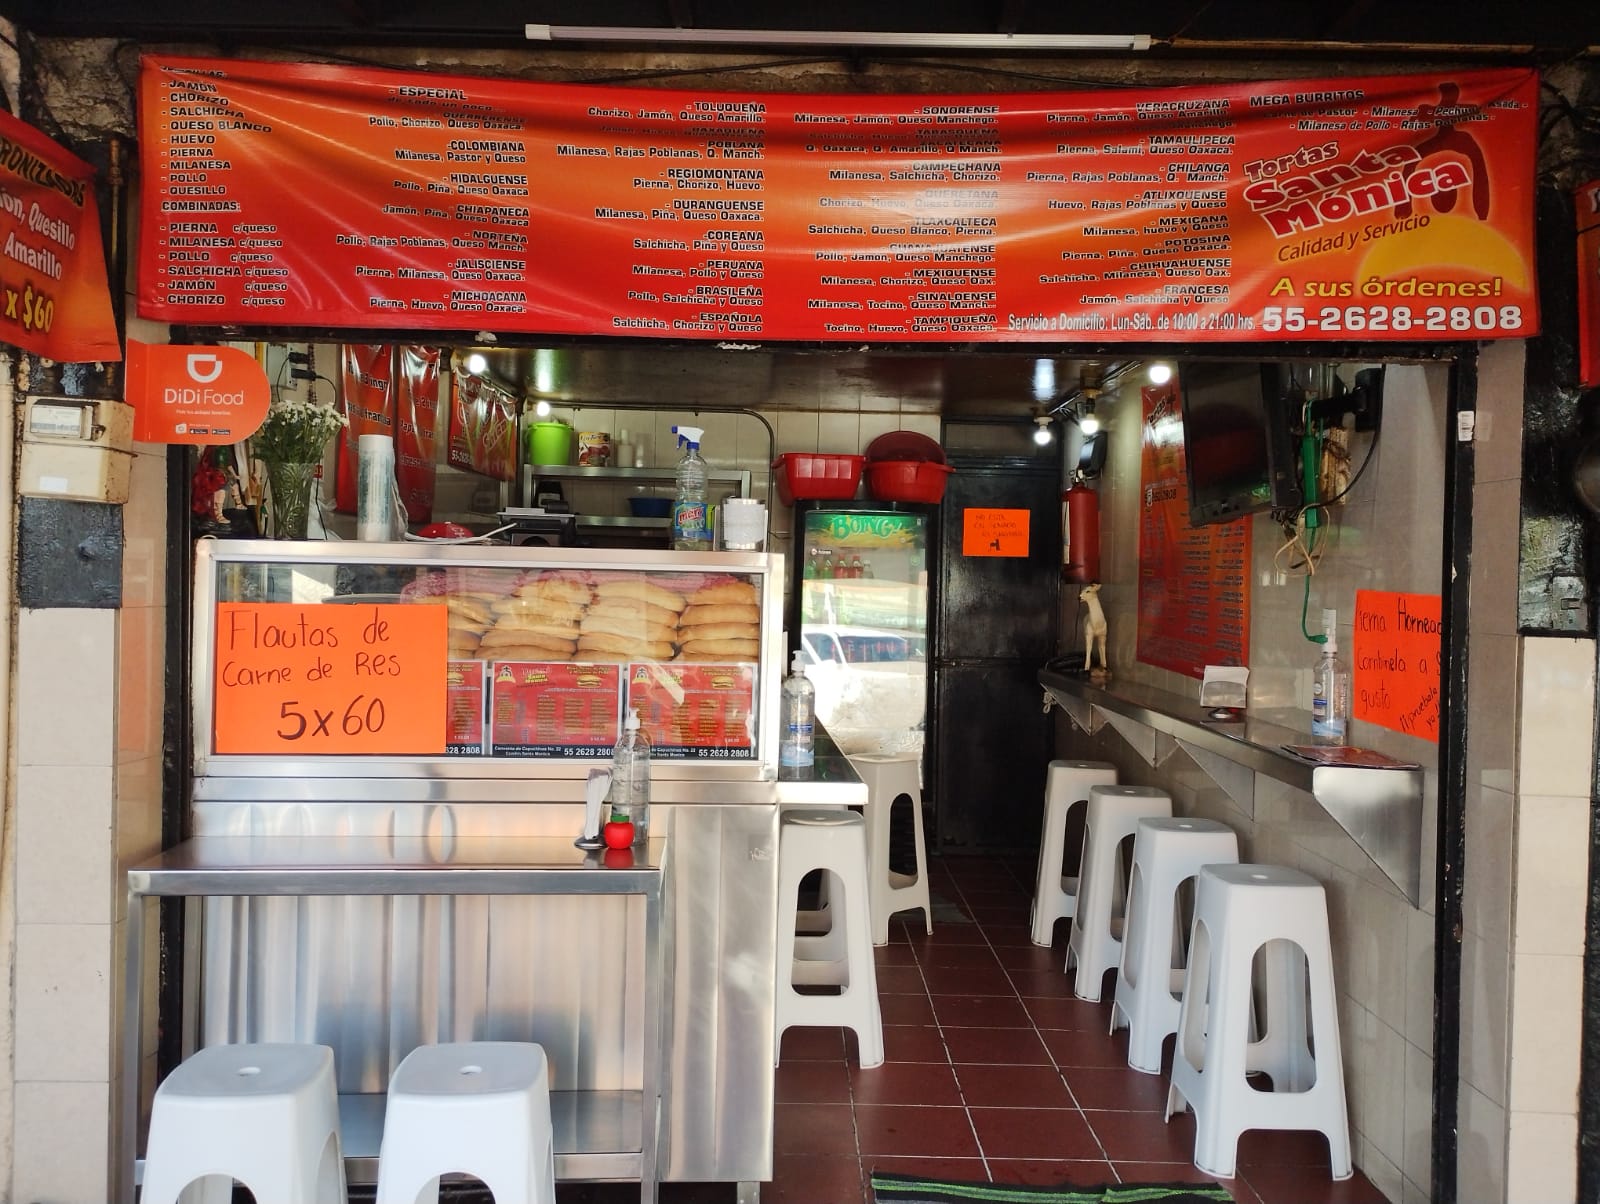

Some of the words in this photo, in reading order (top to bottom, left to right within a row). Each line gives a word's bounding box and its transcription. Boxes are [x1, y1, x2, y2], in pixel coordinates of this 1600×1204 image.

[399, 87, 467, 100] ESPECIAL
[1250, 96, 1292, 106] MEGA
[1296, 91, 1364, 104] BURRITOS
[170, 93, 229, 106] CHORIZO
[923, 106, 998, 114] SONORENSE
[1136, 100, 1230, 111] VERACRUZANA
[170, 107, 244, 119] SALCHICHA
[680, 112, 712, 122] Queso
[898, 116, 932, 124] Queso
[171, 121, 214, 130] QUESO
[218, 122, 272, 133] BLANCO
[171, 135, 216, 144] HUEVO
[1149, 136, 1235, 145] TAMAULIPECA
[170, 148, 214, 158] PIERNA
[395, 150, 443, 162] Milanesa,
[447, 152, 480, 162] Pastor
[494, 153, 525, 163] Queso
[557, 145, 611, 158] Milanesa,
[615, 147, 645, 158] Rajas
[170, 160, 231, 170] MILANESA
[912, 162, 1001, 172] CAMPECHANA
[1244, 141, 1340, 182] Tortas
[1168, 163, 1230, 172] CHILANGA
[170, 174, 206, 183] POLLO
[451, 173, 527, 185] HIDALGUENSE
[668, 169, 764, 180] REGIOMONTANA
[1243, 145, 1422, 211] Santa
[633, 178, 673, 190] Pierna,
[169, 186, 226, 195] QUESILLO
[1143, 190, 1226, 200] ATLIXQUENSE
[673, 200, 764, 210] DURANGUENSE
[1260, 161, 1472, 238] Mónica
[162, 201, 240, 212] COMBINADAS:
[457, 204, 529, 217] CHIAPANECA
[683, 211, 716, 221] Queso
[1159, 215, 1228, 226] MEXICANA
[29, 203, 75, 250] Quesillo
[915, 218, 996, 226] TLAXCALTECA
[170, 223, 218, 233] PIERNA
[871, 226, 906, 235] Queso
[169, 238, 236, 247] MILANESA
[1165, 234, 1231, 246] POTOSINA
[1278, 232, 1344, 262] Calidad
[1349, 229, 1360, 249] y
[1363, 214, 1430, 241] Servicio
[634, 239, 689, 251] Salchicha,
[721, 243, 727, 252] y
[731, 241, 764, 251] Queso
[5, 232, 62, 281] Amarillo
[169, 252, 210, 262] POLLO
[455, 259, 525, 270] JALISCIENSE
[707, 260, 763, 269] PERUANA
[168, 266, 241, 276] SALCHICHA
[356, 266, 394, 278] Pierna,
[452, 270, 482, 280] Queso
[914, 269, 996, 277] MEXIQUENSE
[168, 278, 215, 290] JAMÓN
[1164, 285, 1229, 294] FRANCESA
[1270, 278, 1296, 297] A
[1304, 281, 1352, 297] sus
[1362, 277, 1503, 297] órdenes!
[168, 295, 225, 305] CHORIZO
[451, 291, 526, 302] MICHOACANA
[917, 292, 996, 301] SINALOENSE
[5, 290, 18, 319] x
[24, 286, 54, 333] $60
[451, 301, 482, 311] Queso
[1008, 313, 1048, 330] Servicio
[1051, 318, 1057, 330] a
[1158, 314, 1169, 329] de
[1173, 314, 1198, 329] 10:00
[1201, 318, 1206, 329] a
[1209, 314, 1234, 329] 21:00
[1238, 314, 1255, 329] hrs.
[1262, 306, 1522, 332] 55-2628-2808
[673, 320, 714, 330] Chorizo
[729, 322, 762, 332] Queso
[223, 610, 338, 650] Flautas
[363, 606, 390, 644] de
[222, 661, 291, 687] Carne
[306, 656, 332, 681] de
[355, 651, 400, 677] Res
[460, 746, 480, 754] 2808
[564, 748, 574, 756] 55
[576, 748, 594, 756] 2628
[710, 749, 729, 757] 2628
